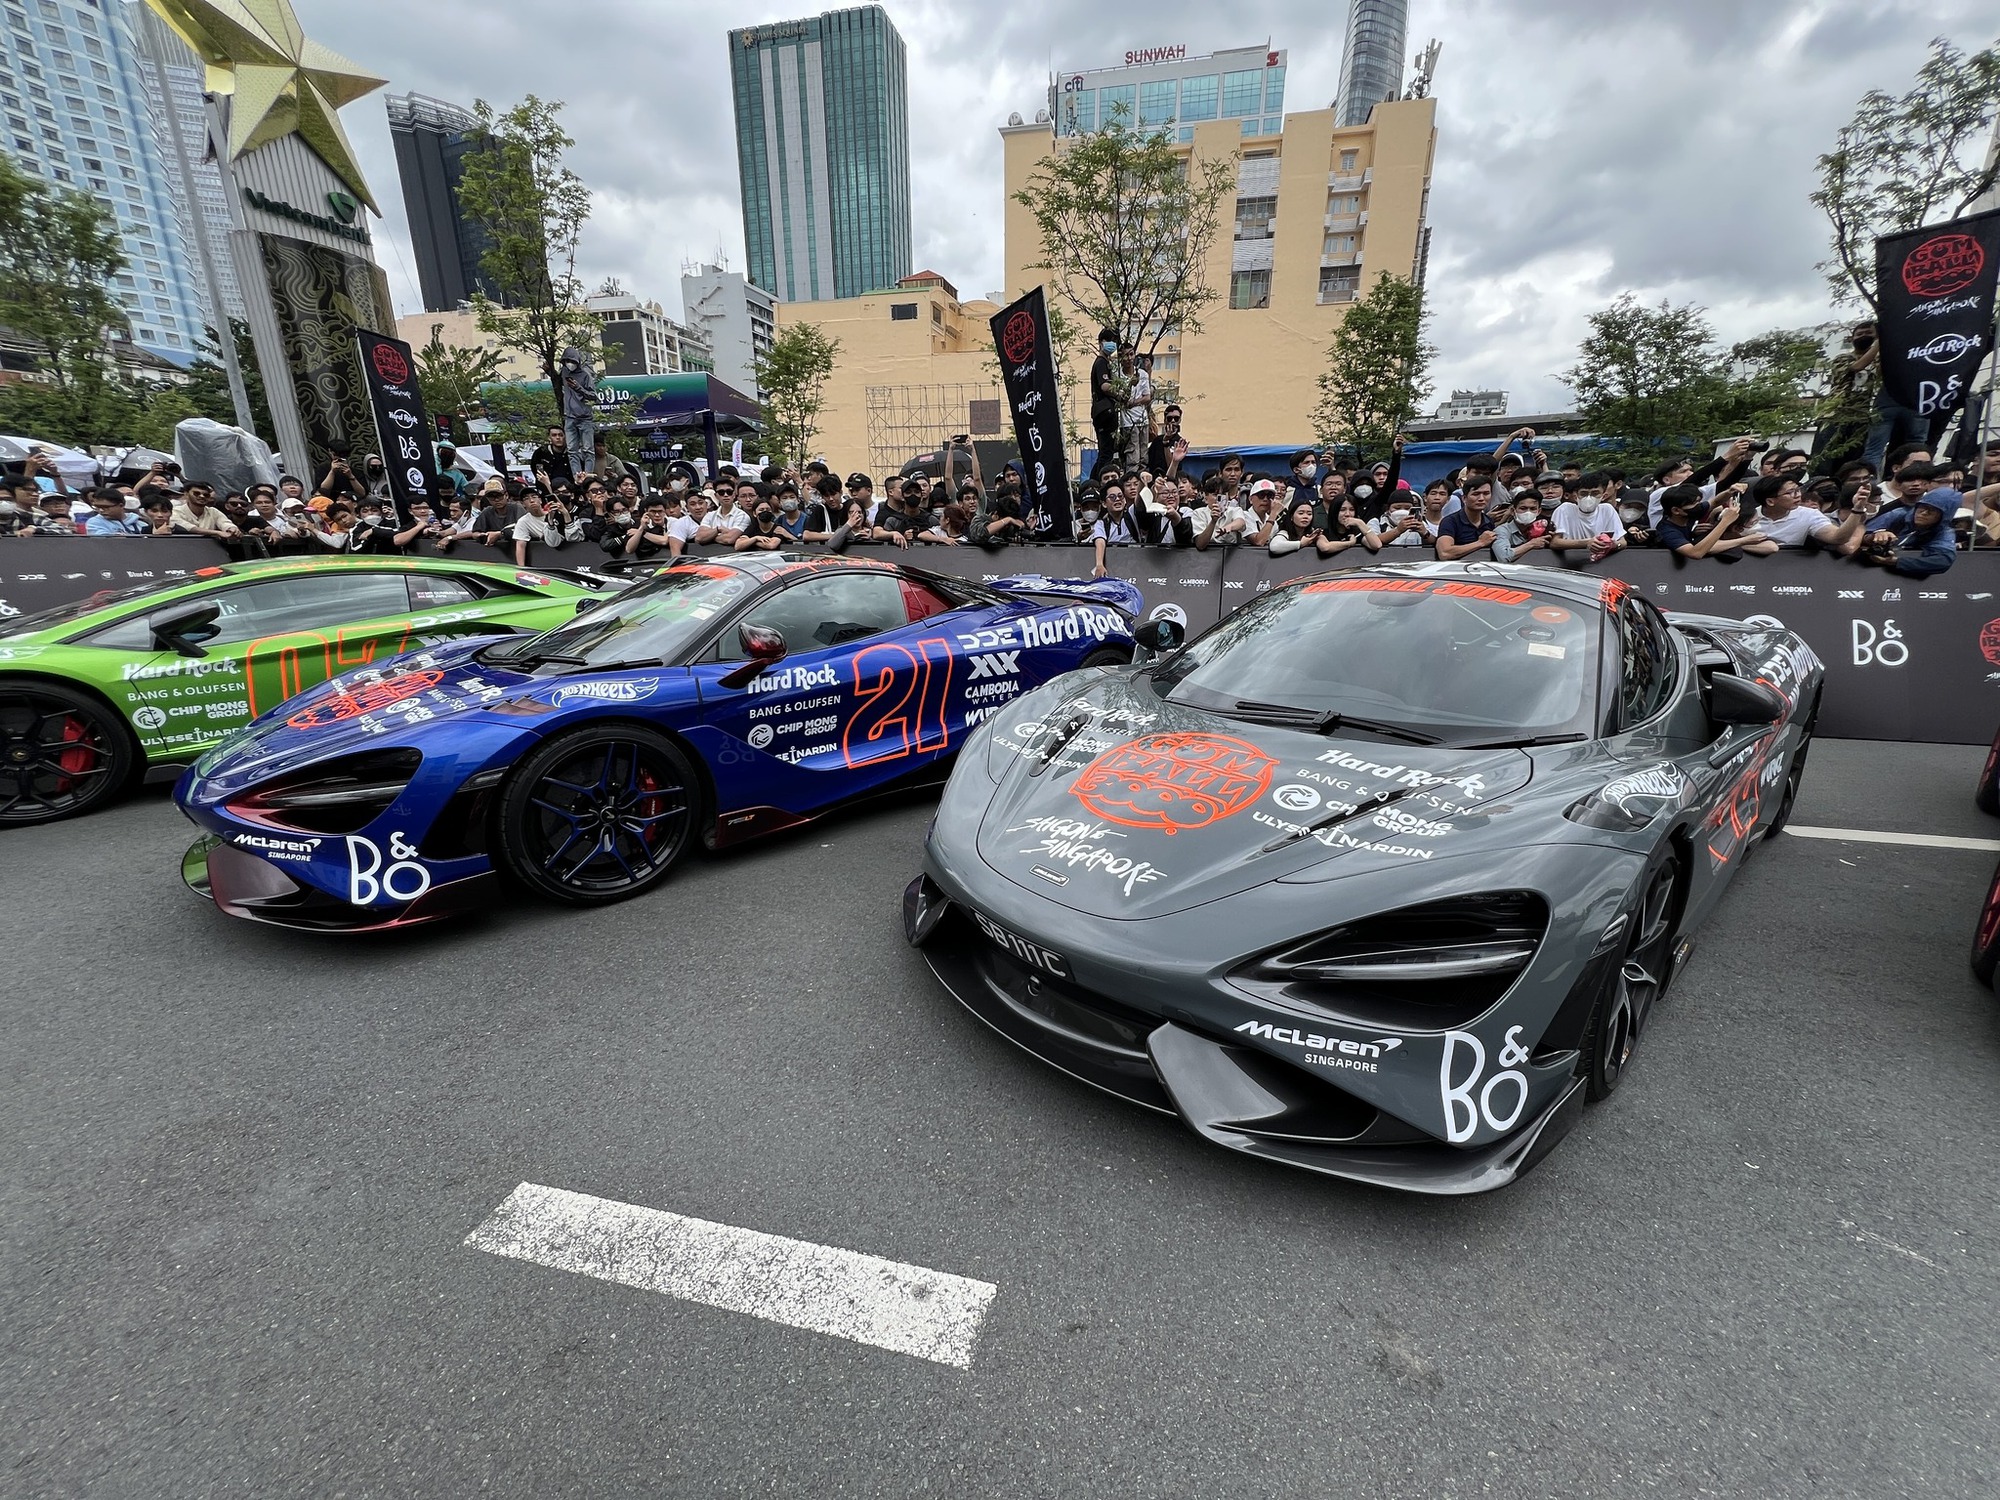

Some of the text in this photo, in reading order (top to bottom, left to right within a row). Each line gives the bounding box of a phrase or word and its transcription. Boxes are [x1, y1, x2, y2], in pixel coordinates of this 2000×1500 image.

[1125, 44, 1186, 65] SUNWAH
[1907, 335, 1982, 360] Hard Rock
[398, 434, 421, 460] B&O
[1301, 579, 1532, 605] GUMBALL 3000
[1017, 606, 1132, 648] Hard Rock
[1852, 618, 1909, 667] B&O
[122, 659, 181, 681] Hard
[127, 682, 246, 702] BANG & OLUFSEN
[965, 680, 1019, 699] CAMBODIA
[972, 693, 1013, 705] WATER
[169, 701, 248, 716] CHIP MONG
[207, 709, 248, 719] GROUP
[749, 695, 841, 719] BANG & OLUFSEN
[843, 638, 953, 769] 21
[776, 715, 838, 735] CHIP MONG
[804, 724, 837, 736] GROUP
[141, 732, 194, 746] ULYSSE
[797, 743, 838, 758] NARDIN
[1315, 749, 1405, 779] Hard
[1296, 769, 1351, 790] BANG
[1356, 786, 1368, 796] &
[1372, 815, 1448, 837] GROUP
[1378, 806, 1454, 831] MONG
[234, 834, 314, 852] McLaren
[1341, 834, 1434, 860] NARDIN
[267, 851, 312, 862] SINGAPORE
[346, 831, 431, 905] B&O
[1020, 839, 1168, 896] SINGAPORE
[1233, 1020, 1381, 1058] McLaren
[1304, 1053, 1378, 1073] SINGAPORE
[1440, 1025, 1529, 1143] B&O
